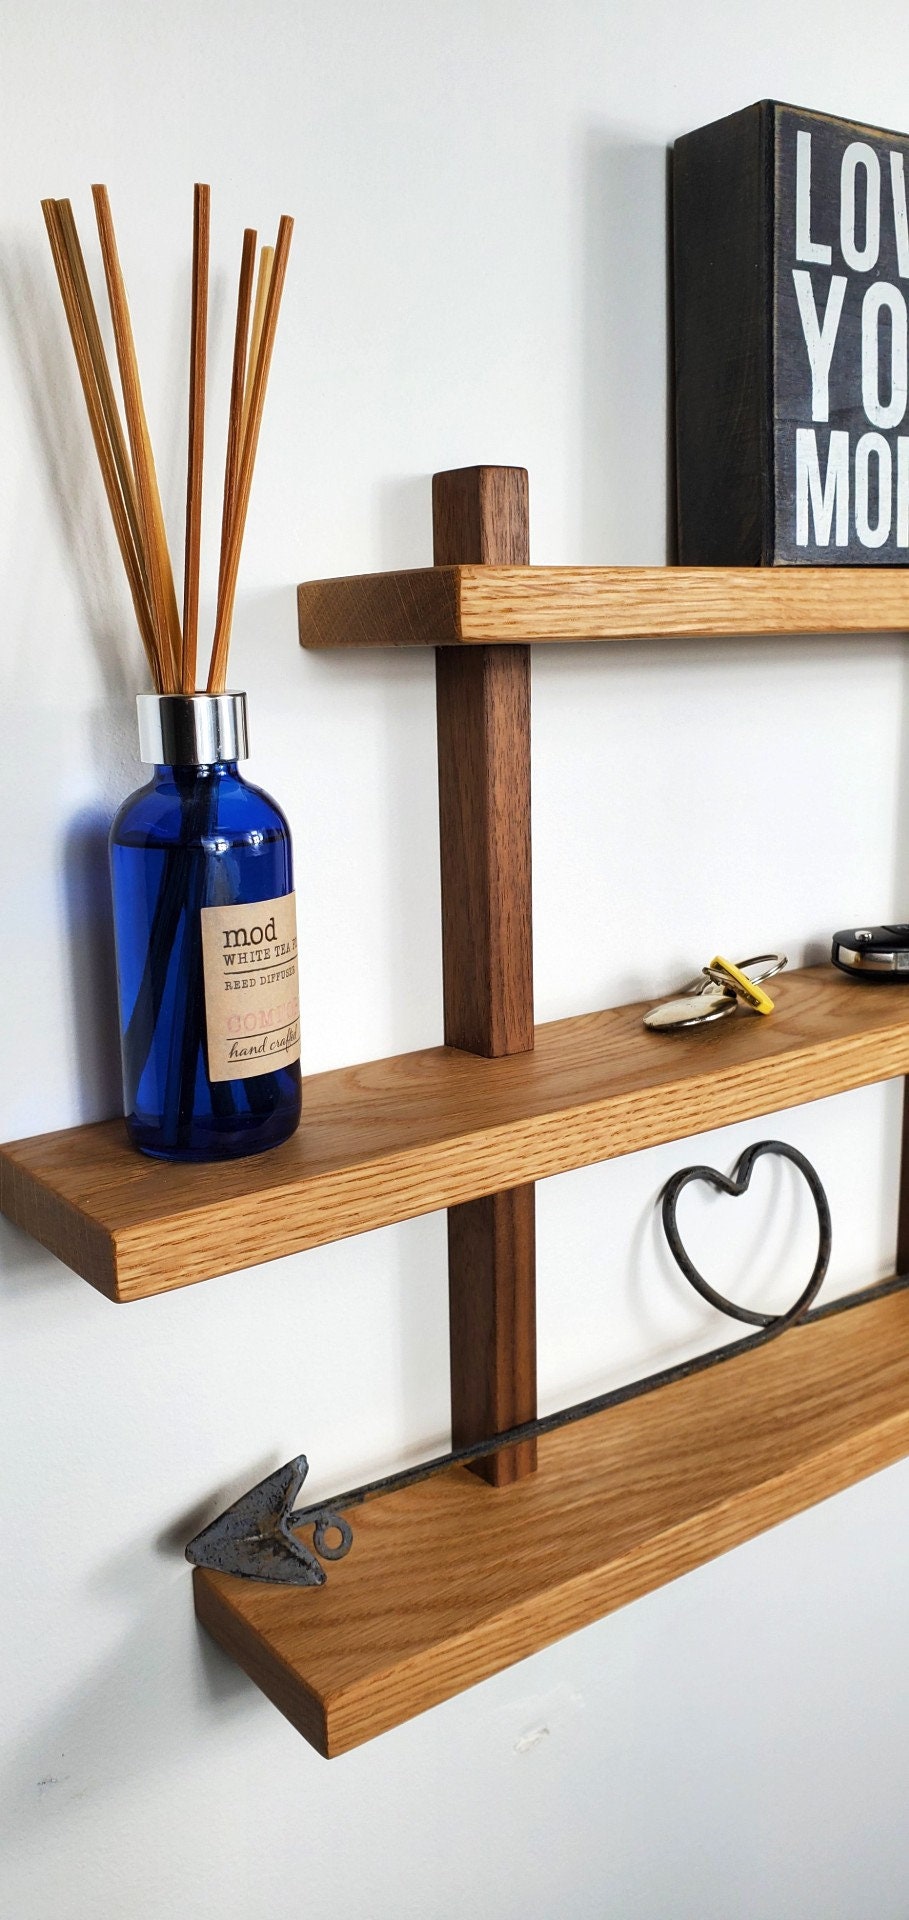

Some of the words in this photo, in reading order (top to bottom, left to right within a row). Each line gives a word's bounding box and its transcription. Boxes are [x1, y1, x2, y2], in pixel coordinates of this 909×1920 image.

[222, 917, 277, 948] mod
[223, 948, 271, 966] WHITE
[275, 943, 291, 957] TEA
[224, 979, 257, 991] REED
[229, 1036, 268, 1059] hand
